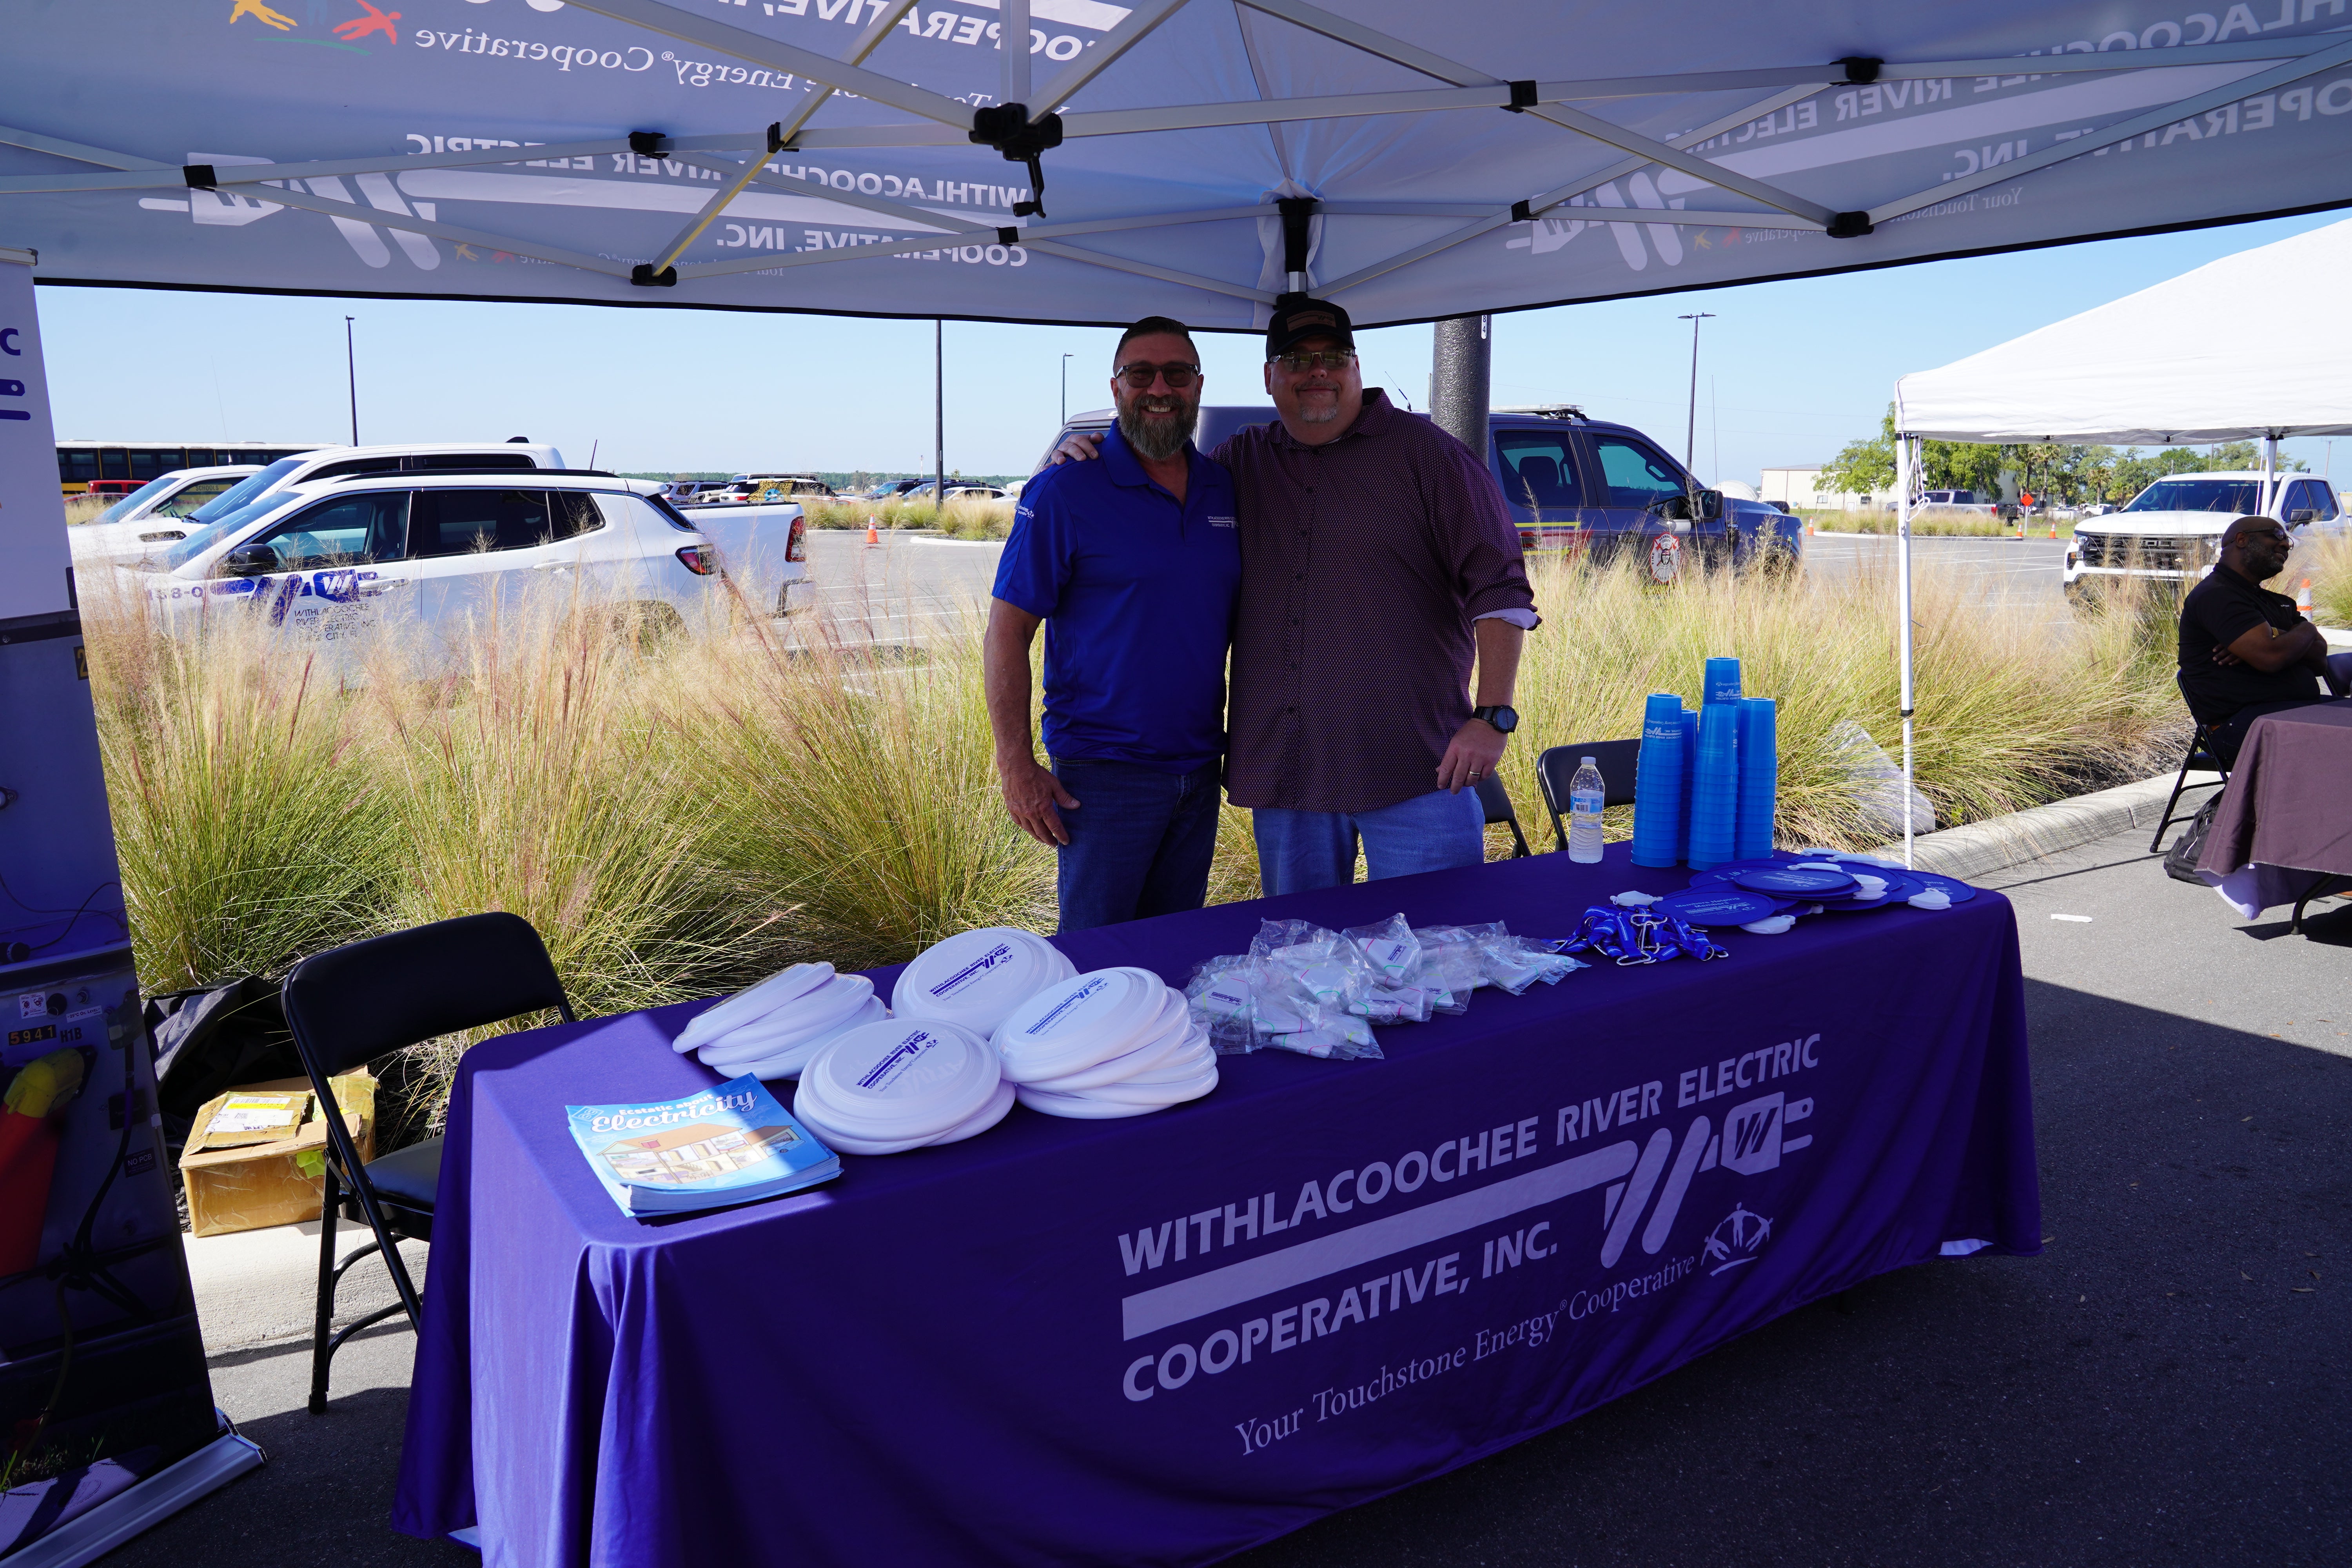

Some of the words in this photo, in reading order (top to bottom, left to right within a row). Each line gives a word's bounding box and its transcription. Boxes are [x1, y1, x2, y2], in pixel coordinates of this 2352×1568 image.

[929, 967, 969, 993] WITHLACOOCHEE
[970, 957, 984, 967] RIVER
[984, 942, 1005, 957] ELECTRIC
[982, 963, 1001, 976] Cooperative
[936, 976, 970, 997] COOPERATIVE,
[1025, 1002, 1063, 1034] WITHLACOOCHEE
[1063, 992, 1077, 1002] RIVER
[1078, 977, 1098, 991] ELECTRIC
[1033, 1009, 1065, 1035] COOPERATIVE,
[10, 1025, 54, 1045] 5941
[856, 1055, 891, 1086] WITHLACOOCHEE
[890, 1045, 903, 1055] RIVER
[902, 1030, 920, 1044] ELECTRIC
[868, 1063, 897, 1089] COOPERATIVE,
[591, 1091, 759, 1132] Electricity
[619, 1104, 674, 1116] Ecstatic
[676, 1094, 714, 1109] about
[128, 1158, 138, 1167] NO
[139, 1154, 152, 1163] PCB
[1118, 1116, 1539, 1276] WITHLACOOCHEE
[1556, 1080, 1663, 1146] RIVER
[1678, 1033, 1820, 1108] ELECTRIC
[1122, 1252, 1470, 1402] COOPERATIVE,
[1482, 1221, 1557, 1279] INC.
[1235, 1408, 1304, 1457] Your
[1312, 1350, 1465, 1422] Touchstone
[1569, 1254, 1695, 1321] Cooperative
